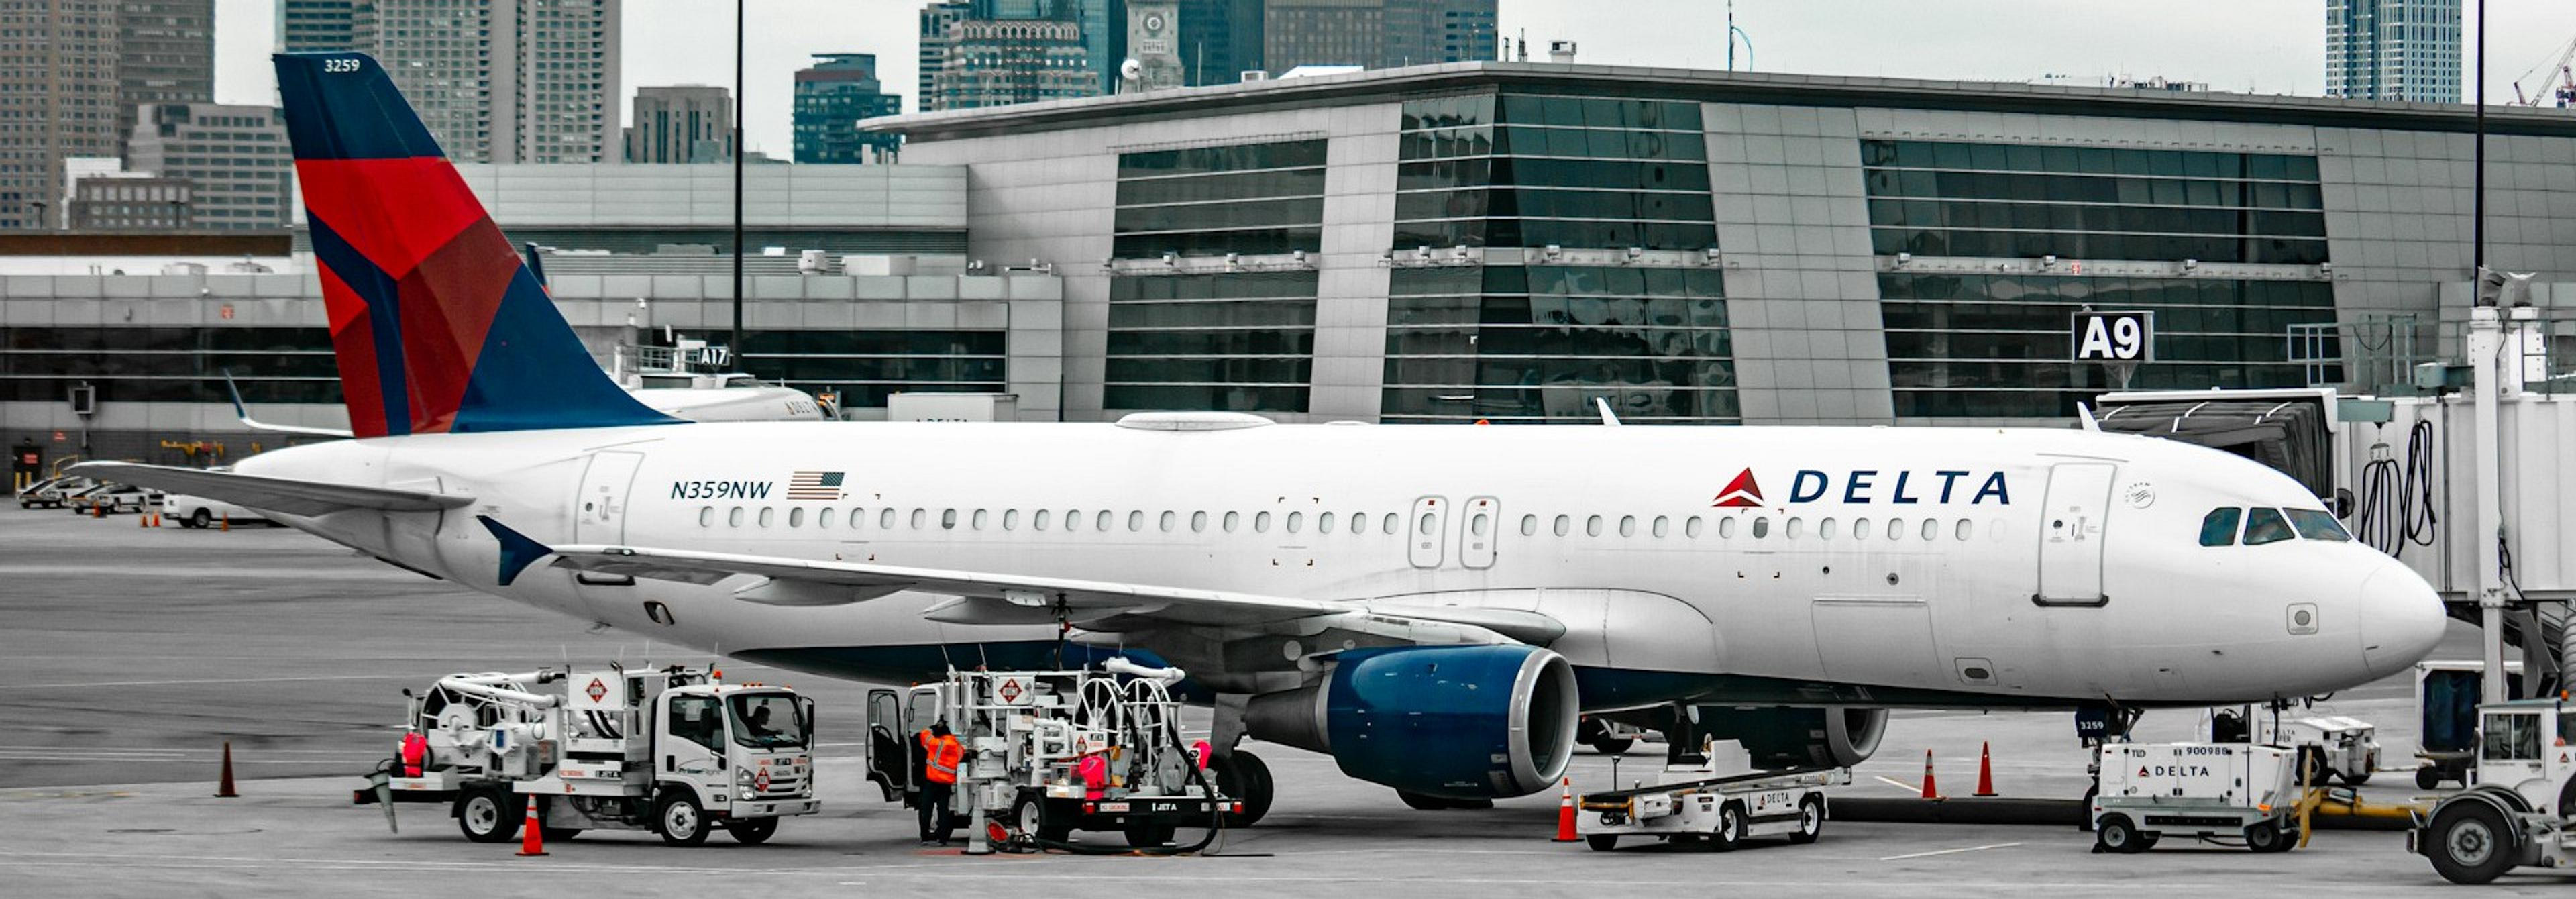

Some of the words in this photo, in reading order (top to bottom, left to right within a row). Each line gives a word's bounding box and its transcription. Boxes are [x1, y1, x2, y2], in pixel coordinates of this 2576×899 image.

[325, 59, 360, 72] 3259
[2079, 317, 2141, 359] A9
[702, 348, 727, 364] A17
[671, 481, 773, 499] N359NW
[1789, 470, 2010, 505] DELTA
[2080, 721, 2104, 730] 3259
[2155, 766, 2209, 776] DELTA
[1767, 793, 1790, 803] DELTA
